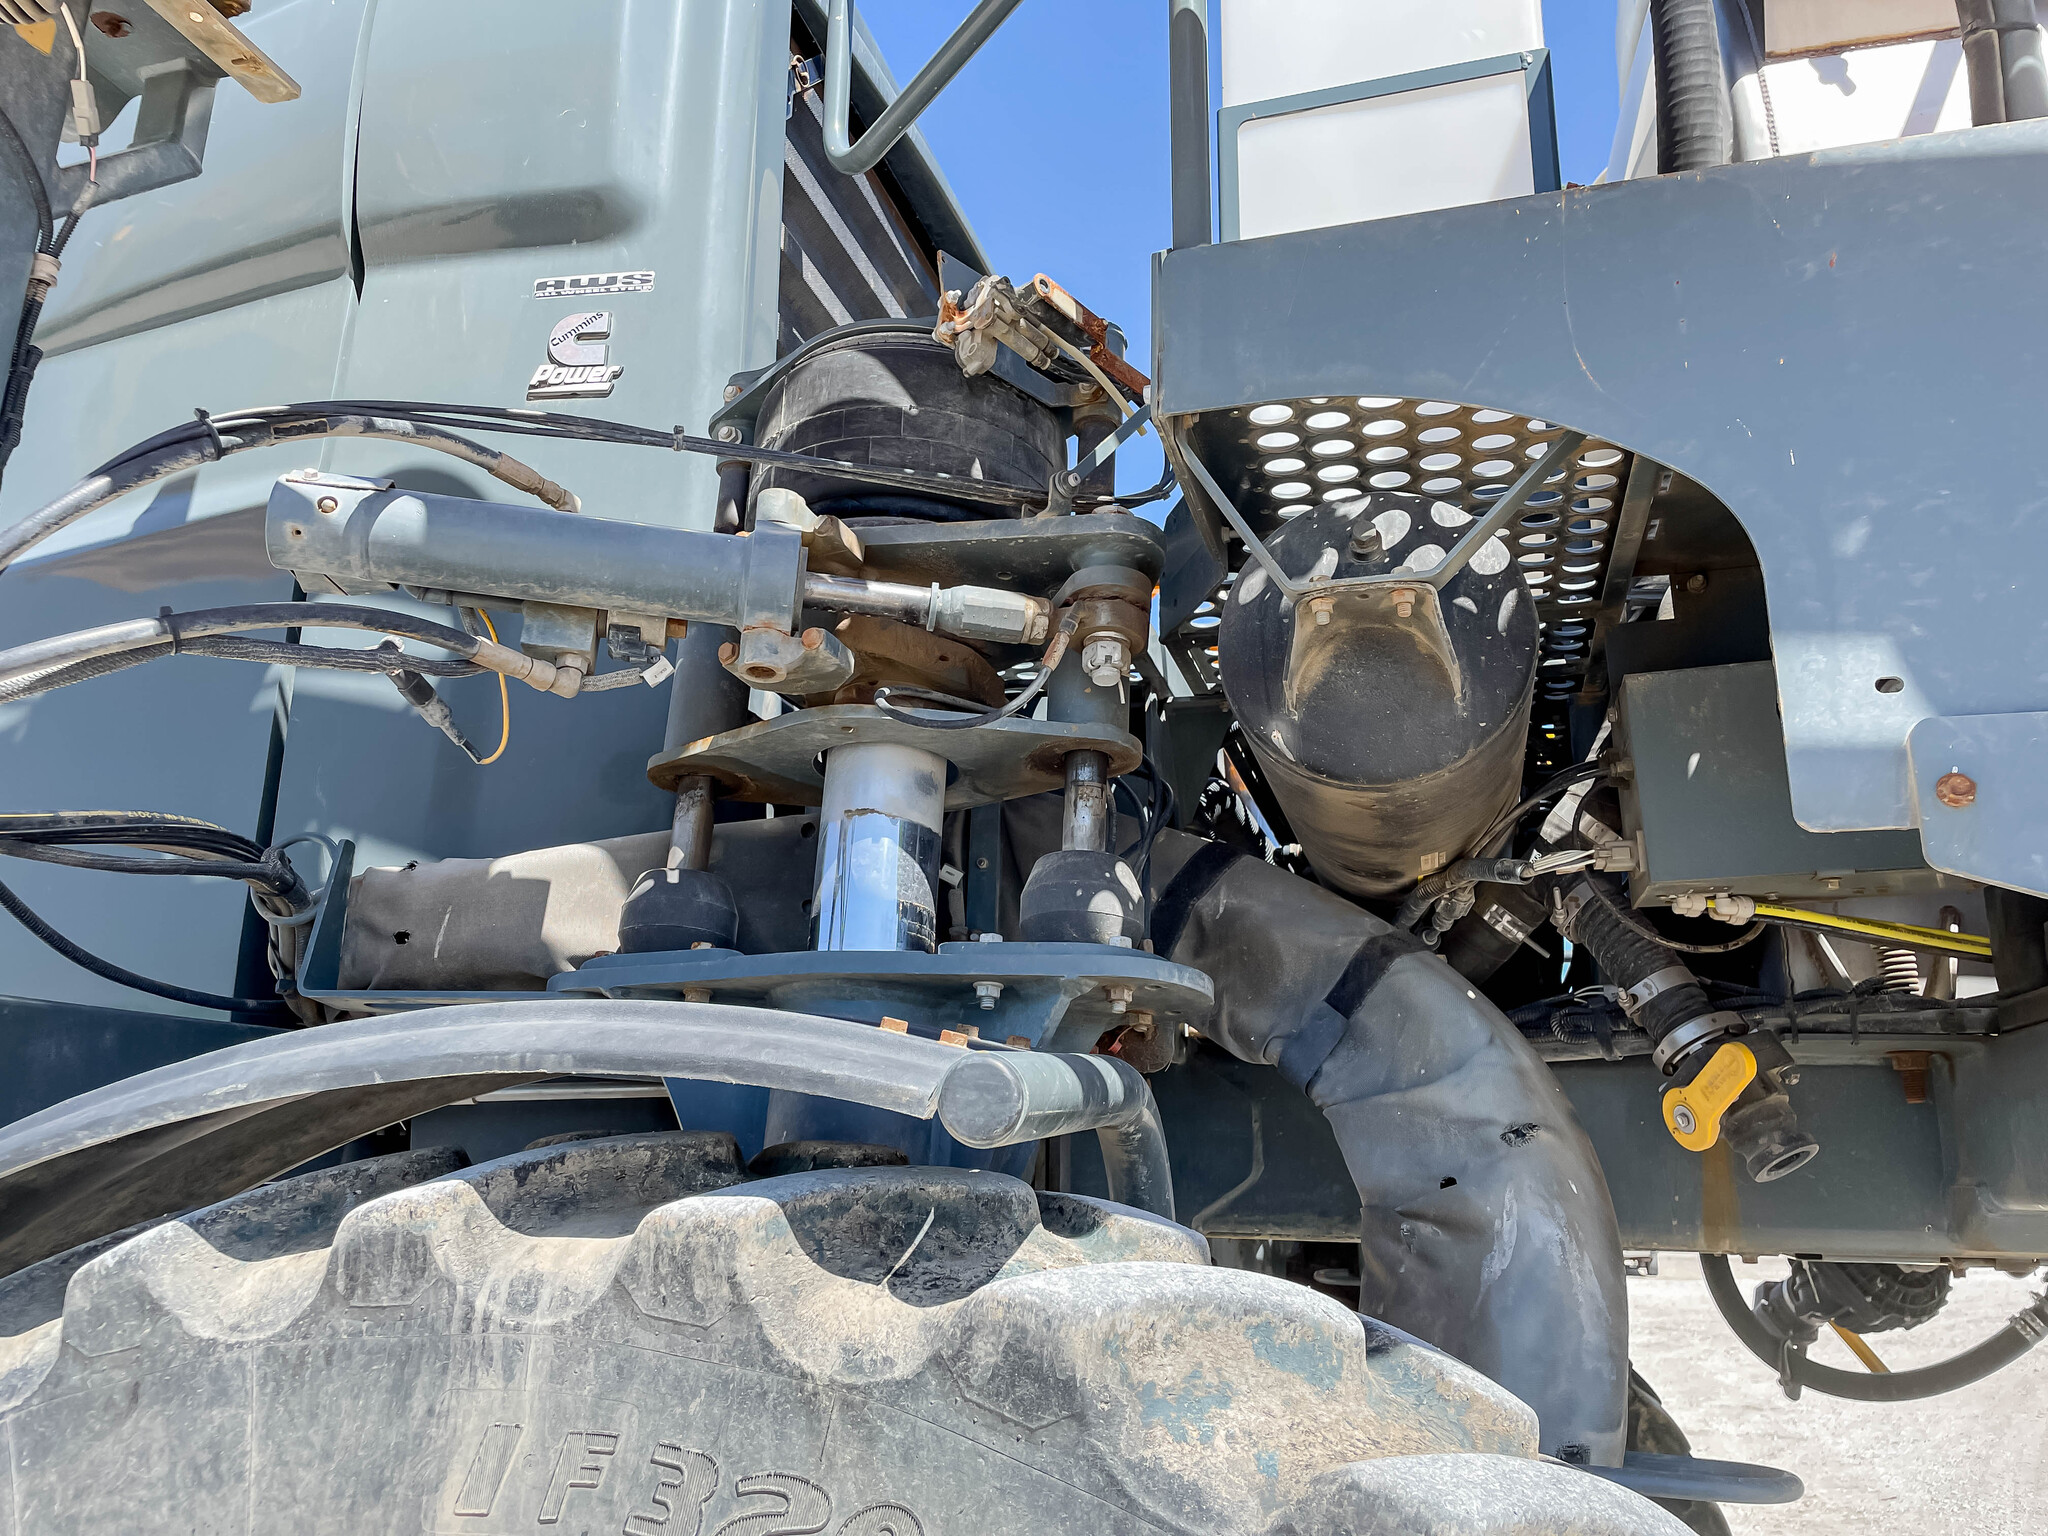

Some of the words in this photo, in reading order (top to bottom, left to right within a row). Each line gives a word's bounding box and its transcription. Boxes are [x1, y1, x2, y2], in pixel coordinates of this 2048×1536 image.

[535, 274, 654, 292] AWS
[551, 312, 604, 347] Cummins
[529, 364, 624, 387] Power
